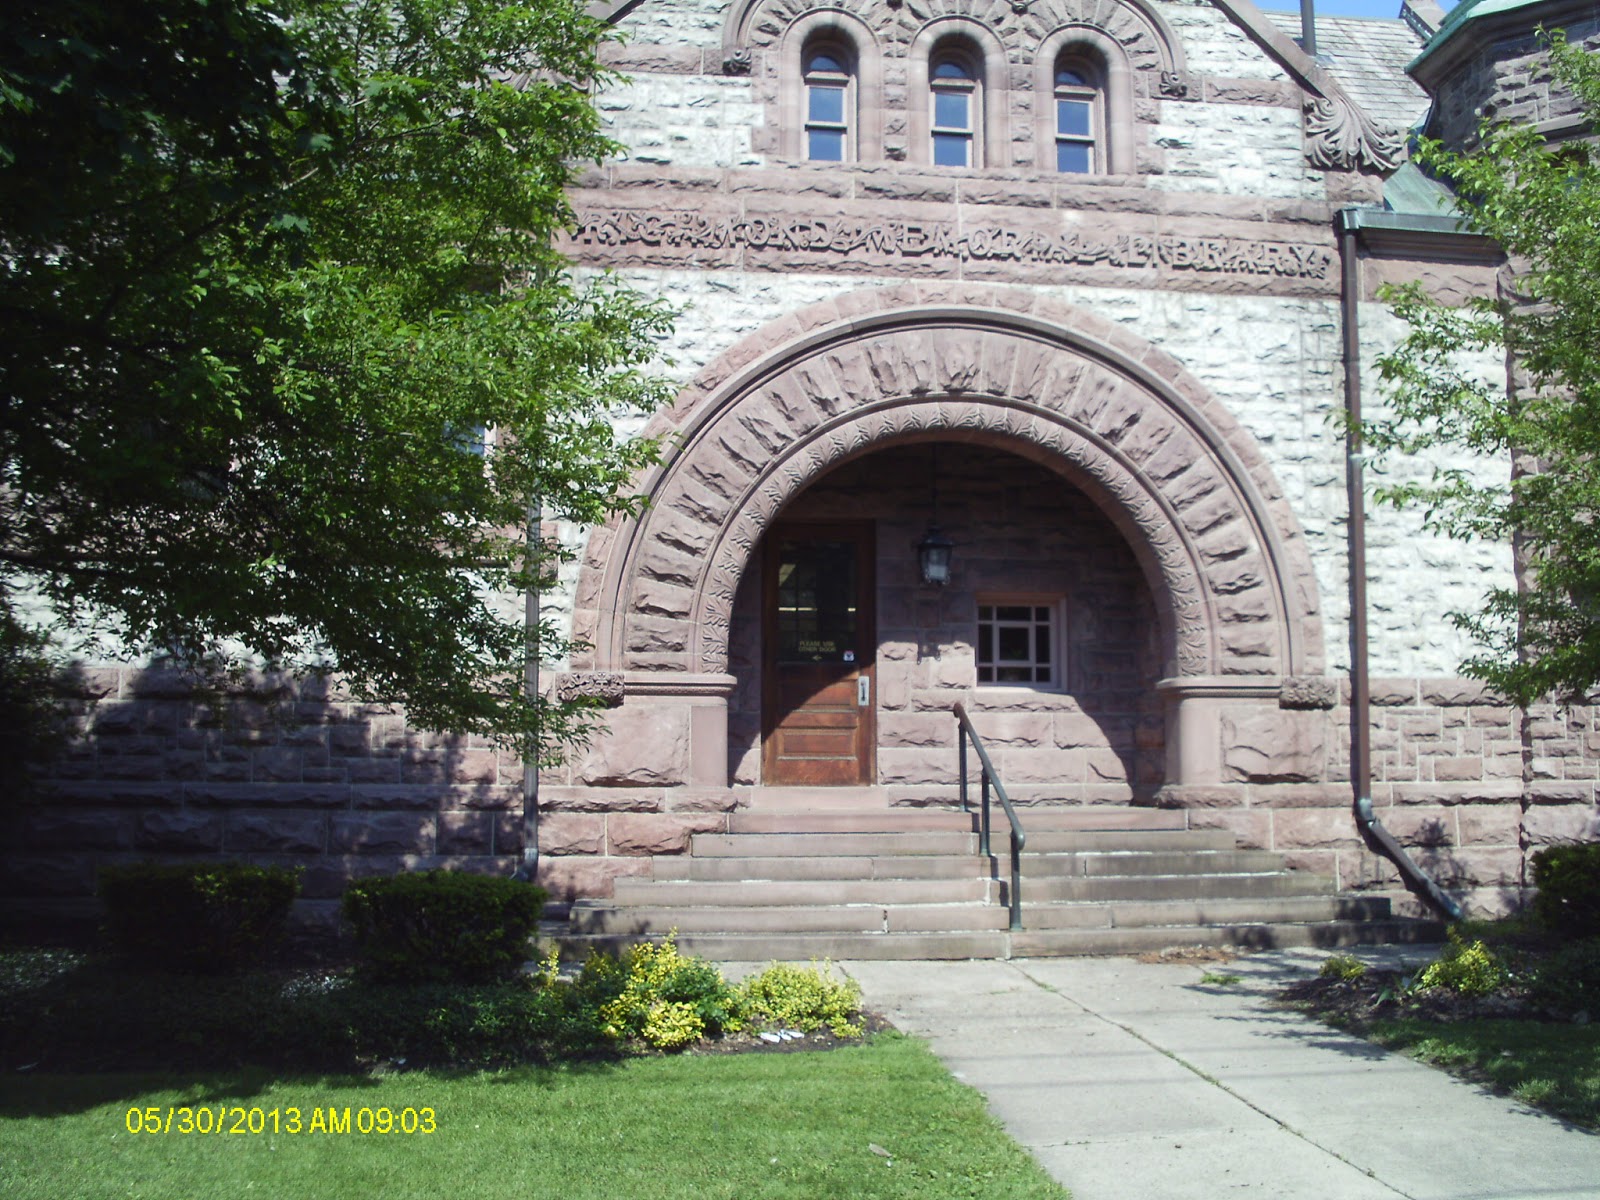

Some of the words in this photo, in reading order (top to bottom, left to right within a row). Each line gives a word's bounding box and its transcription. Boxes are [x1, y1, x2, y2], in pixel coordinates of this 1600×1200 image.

[581, 210, 834, 253] RICHMOND
[865, 221, 1098, 265] MEMORIAL
[1127, 234, 1317, 278] LIBRARY
